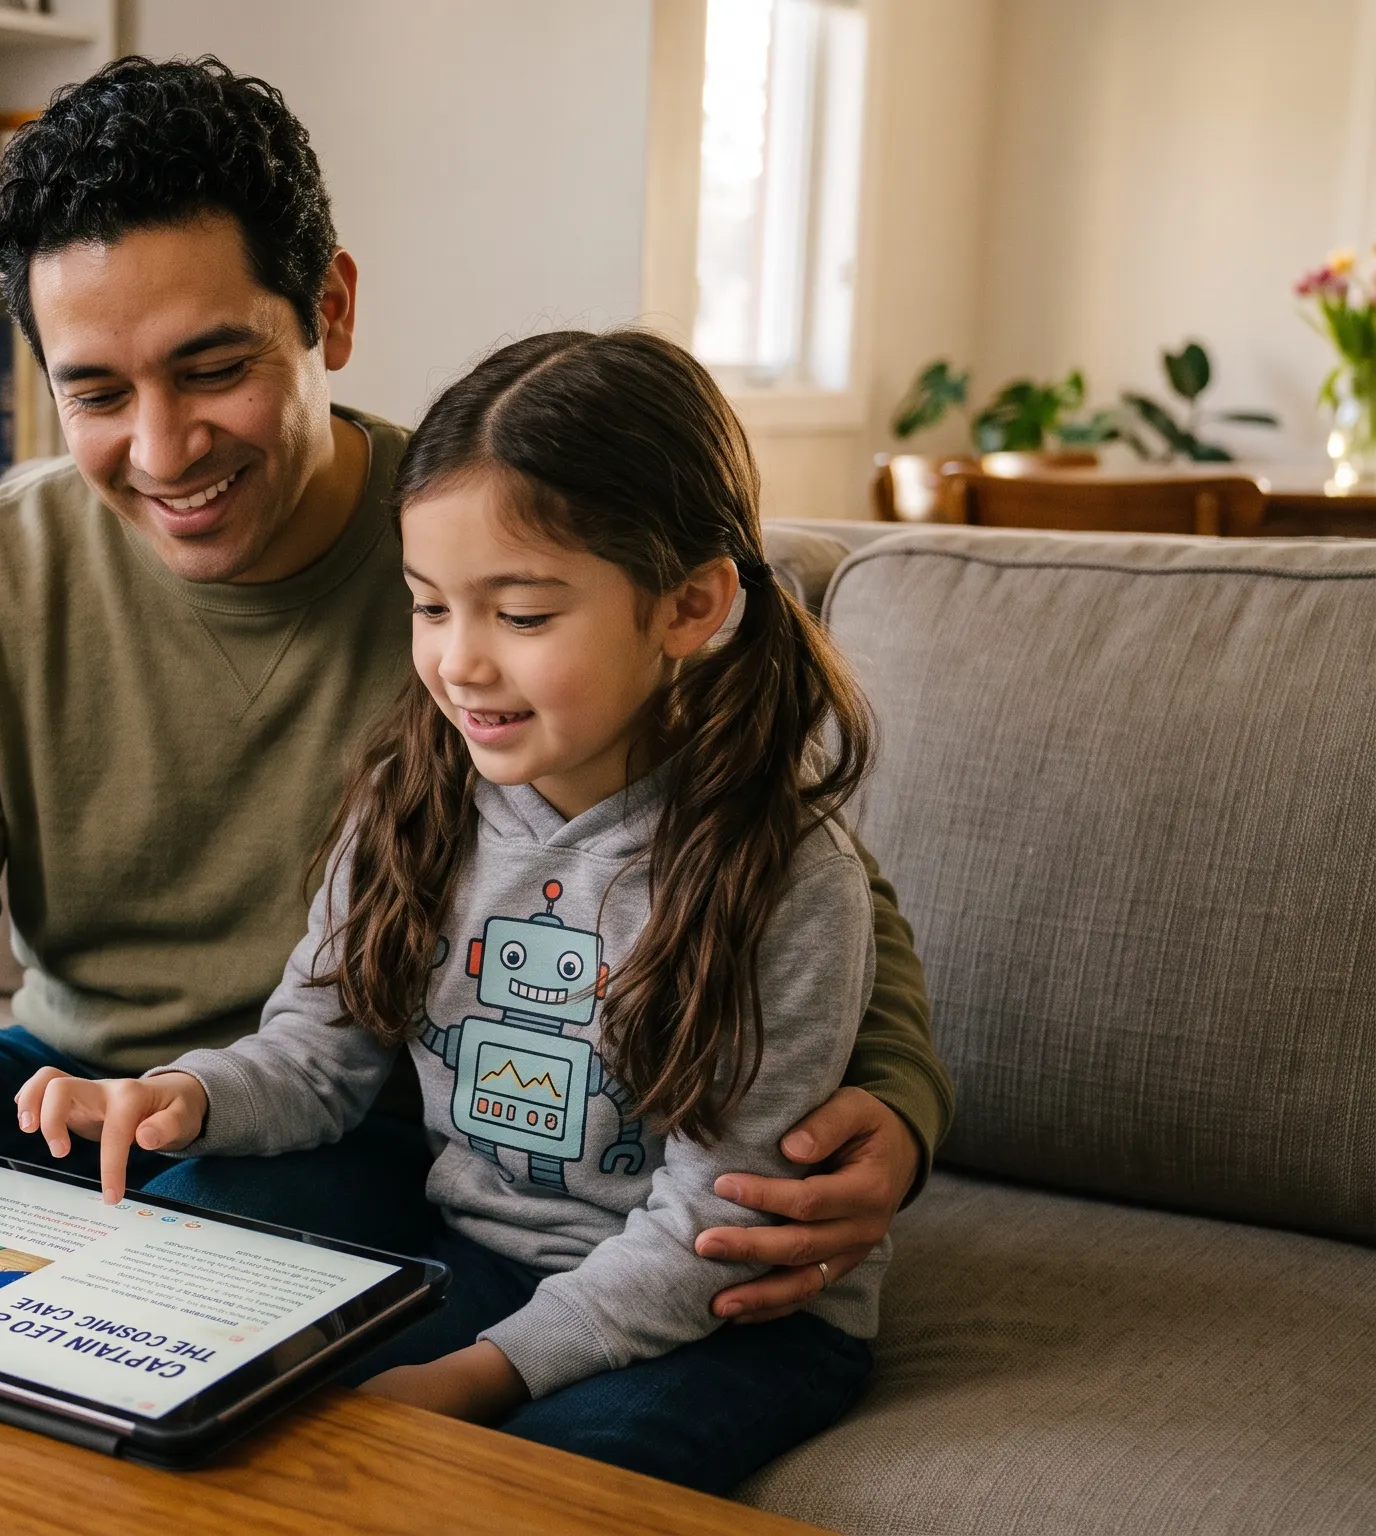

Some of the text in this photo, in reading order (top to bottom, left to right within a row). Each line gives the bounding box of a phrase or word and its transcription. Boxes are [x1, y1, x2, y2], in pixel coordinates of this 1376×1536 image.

[9, 1320, 68, 1343] LEO
[10, 1297, 216, 1363] THE COSMIC CAVE
[62, 1336, 187, 1378] CAPTAIN
